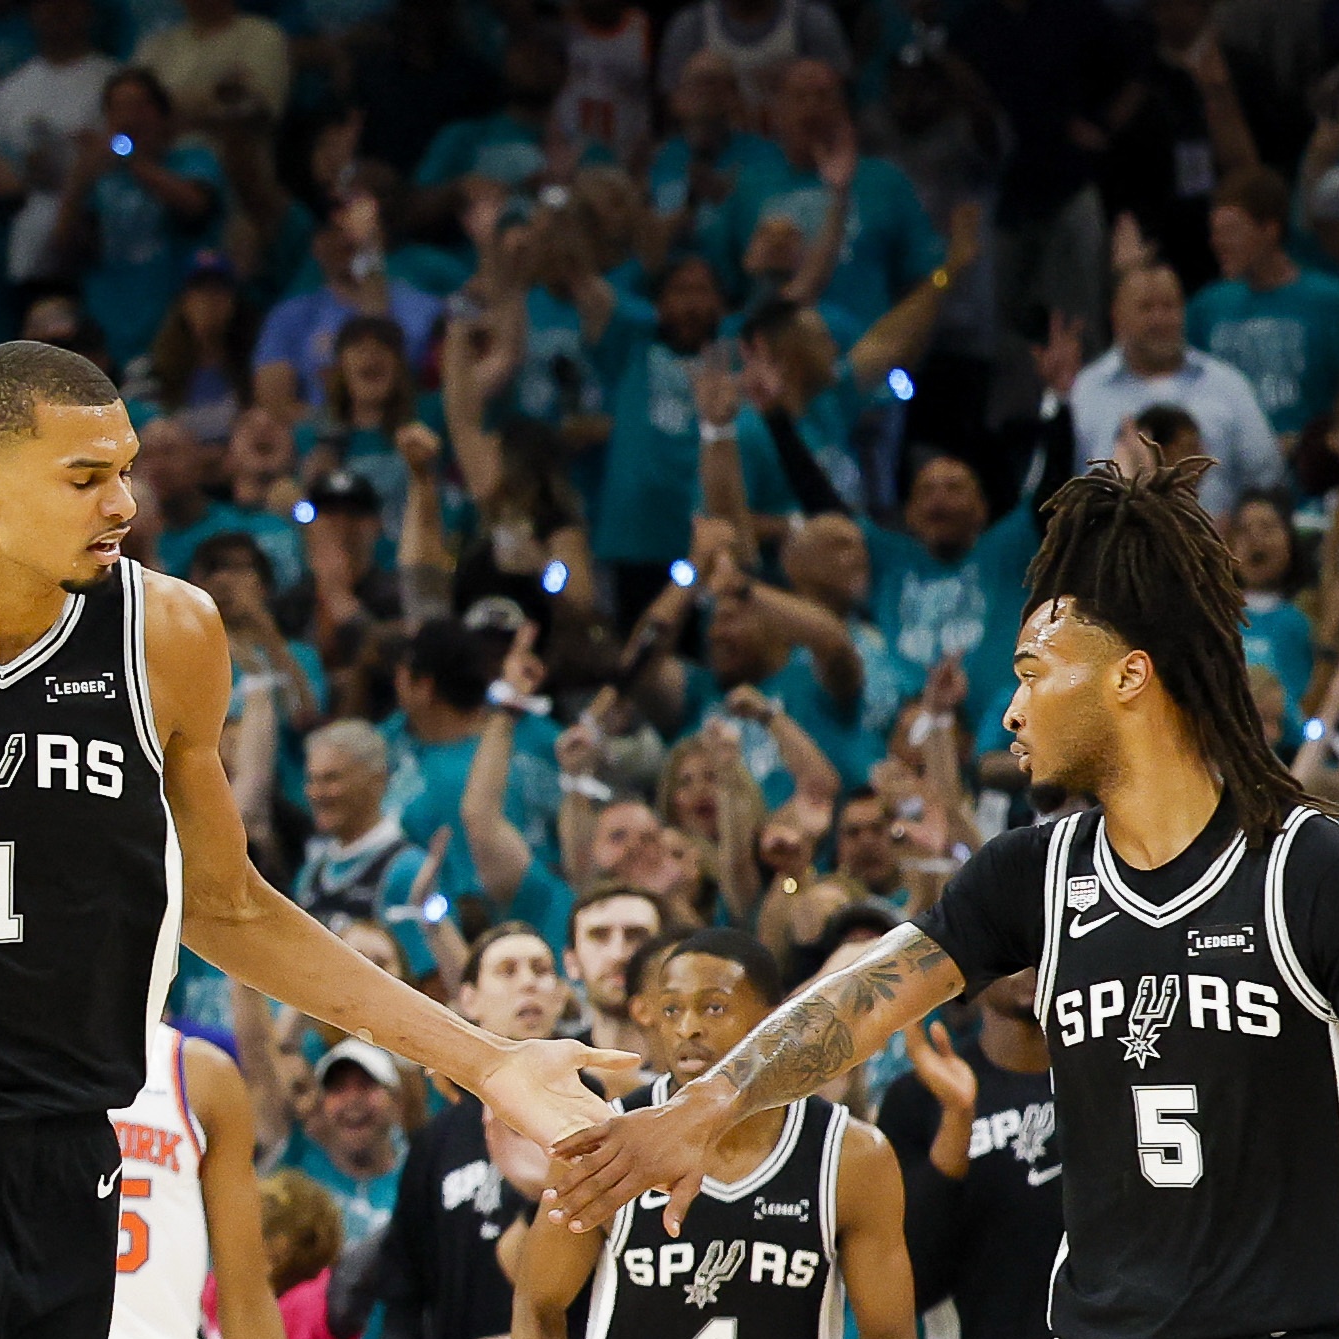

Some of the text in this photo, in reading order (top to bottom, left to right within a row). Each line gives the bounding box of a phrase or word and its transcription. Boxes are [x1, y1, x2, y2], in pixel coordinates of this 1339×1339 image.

[54, 680, 106, 695] LEDGER
[1194, 934, 1246, 949] LEDGER
[1055, 973, 1282, 1069] SPURS
[114, 1120, 183, 1173] ORK
[968, 1101, 1056, 1163] SPU
[1131, 1084, 1203, 1188] 5
[623, 1239, 820, 1310] SPURS
